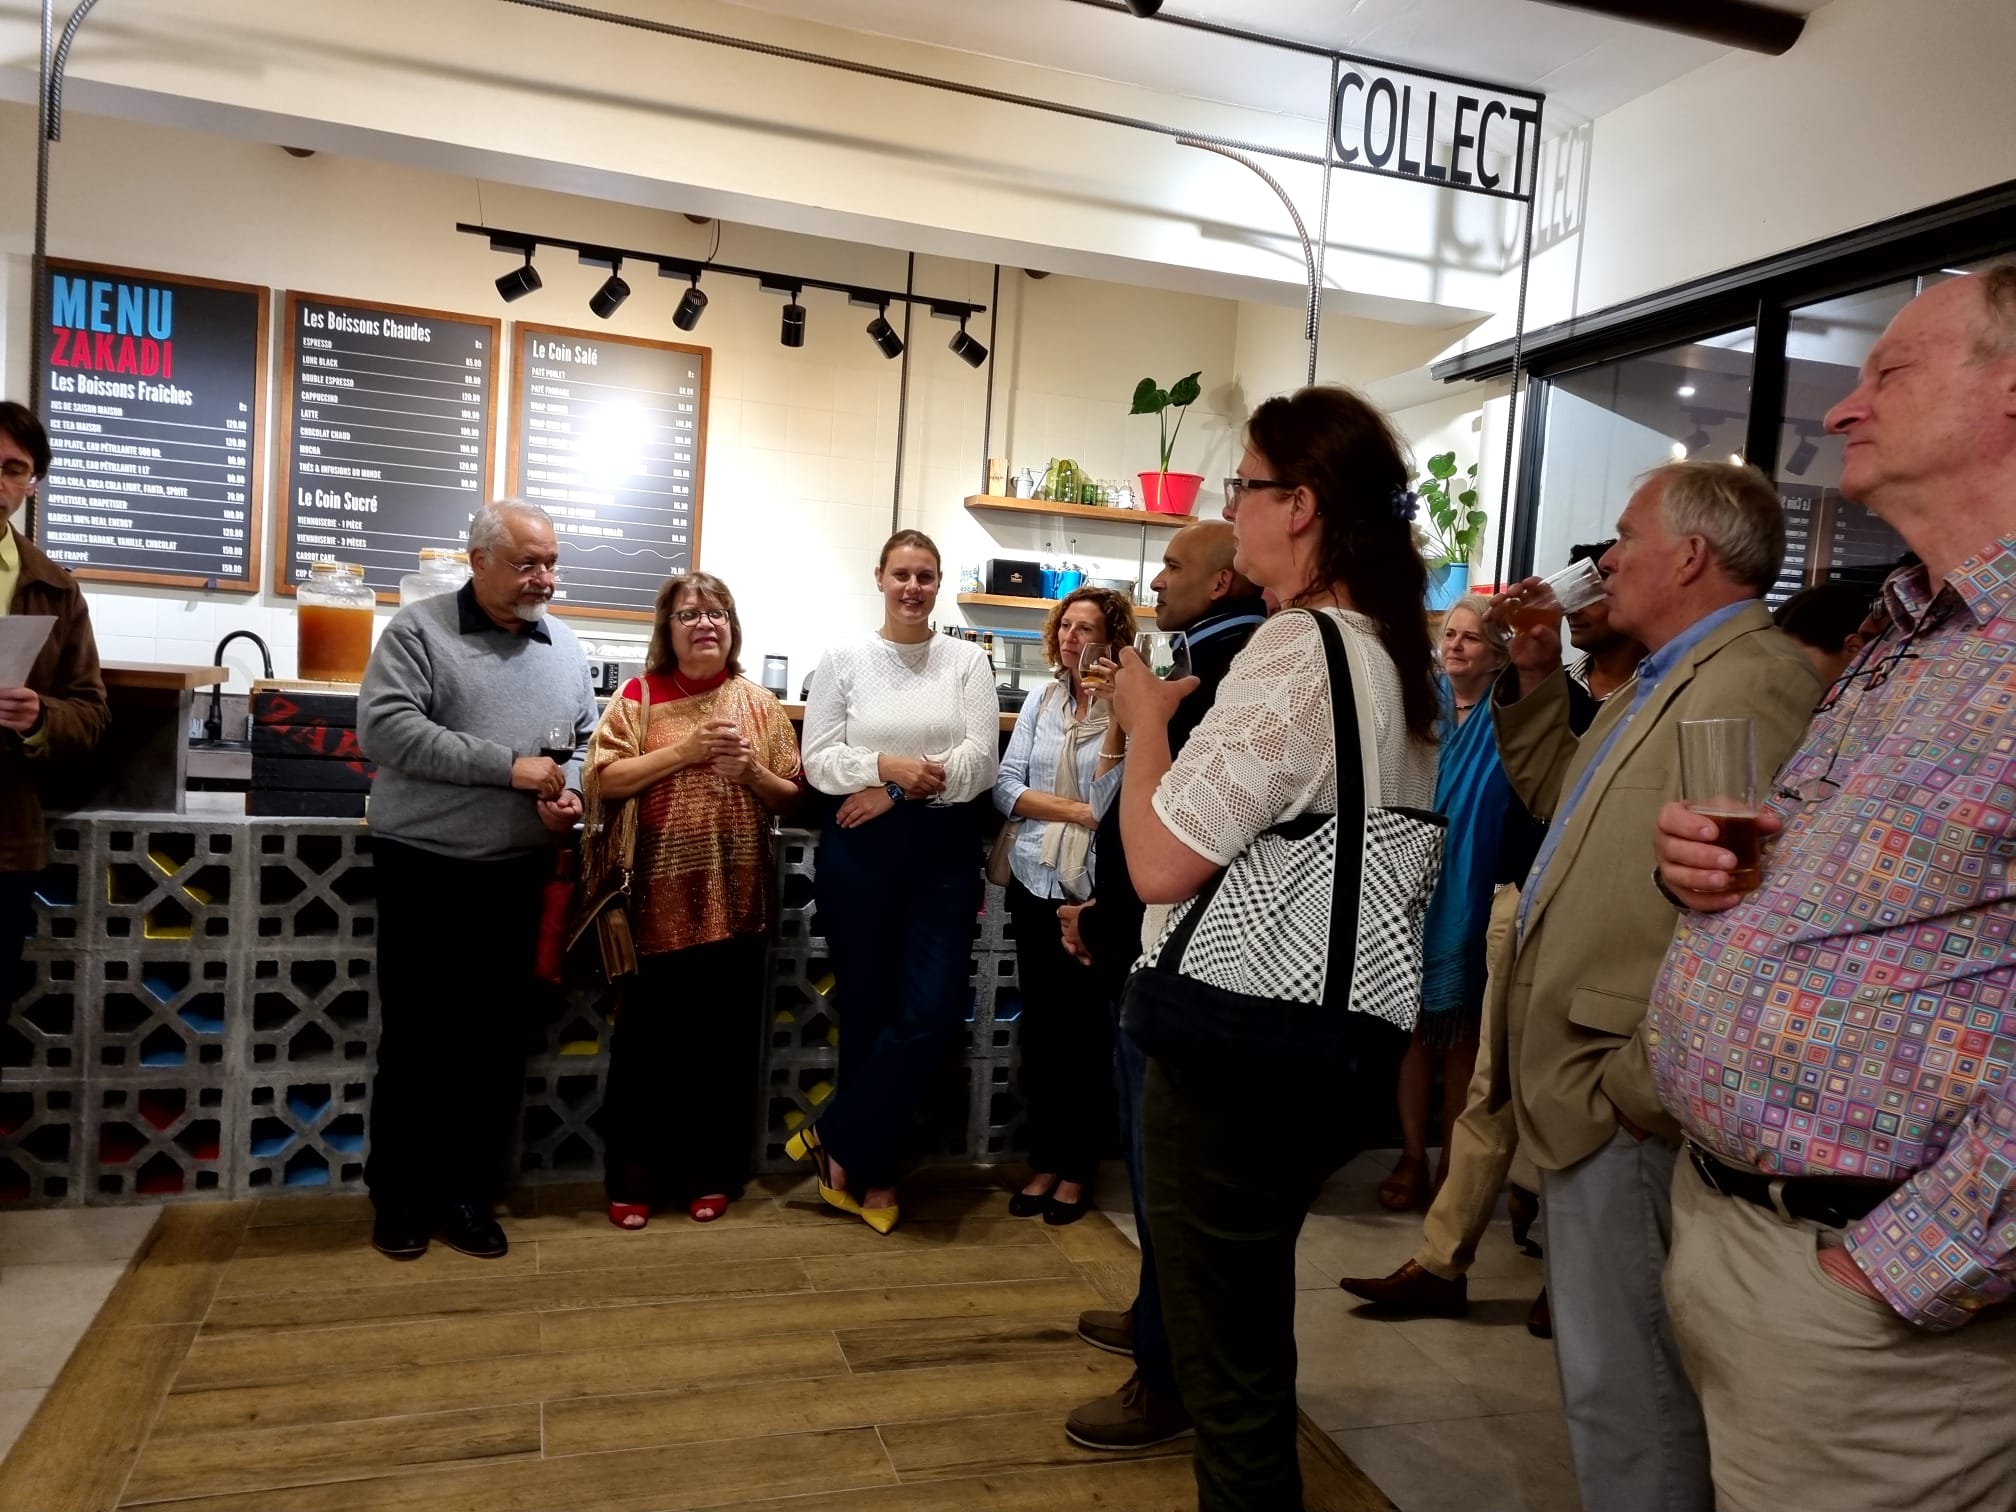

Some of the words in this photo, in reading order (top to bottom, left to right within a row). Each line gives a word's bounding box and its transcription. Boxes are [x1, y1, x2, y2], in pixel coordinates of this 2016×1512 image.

[1334, 72, 1538, 194] COLLECT
[53, 275, 173, 340] MENU
[303, 307, 325, 329] Les
[327, 310, 380, 336] Boissons
[382, 318, 431, 343] Chaudes
[302, 337, 332, 349] ESPRESSO
[50, 327, 173, 379] ZAKADI
[533, 340, 546, 358] Le
[548, 342, 572, 362] Coin
[574, 345, 598, 366] Salé
[302, 355, 318, 366] LONG
[318, 356, 338, 368] BLACK
[301, 372, 324, 384] DOUBLE
[325, 376, 354, 388] ESPRESSO
[51, 370, 75, 393] Les
[77, 373, 136, 400] Boissons
[138, 380, 193, 406] Fraîches
[301, 390, 339, 404] CAPPUCCINO
[63, 401, 73, 411] DE
[73, 402, 97, 414] SAISON
[97, 405, 123, 416] MAISON
[300, 408, 319, 420] LATTE
[50, 419, 61, 429] ICE
[62, 420, 75, 430] TEA
[76, 422, 102, 433] MAISON
[300, 426, 330, 438] CHOCOLAT
[330, 429, 351, 441] CHAUD
[49, 438, 63, 448] EAU
[64, 439, 86, 450] PLATE,
[86, 441, 100, 451] EAU
[64, 457, 86, 469] PLATE,
[86, 460, 99, 471] EAU
[299, 461, 314, 473] THÉS
[320, 464, 352, 477] INFUSIONS
[48, 475, 67, 486] COCA
[67, 477, 87, 488] COLA,
[87, 479, 104, 489] COCA
[105, 480, 122, 491] COLA
[143, 484, 165, 496] FANTA,
[166, 486, 188, 497] SPRITE
[89, 498, 128, 510] GRAPETISER
[298, 487, 312, 507] Le
[315, 489, 341, 509] Coin
[344, 491, 378, 513] Sucré
[91, 516, 108, 526] REAL
[108, 517, 133, 528] ENERGY
[297, 515, 337, 528] VIENNOISERIE
[345, 519, 363, 530] PIÈCE
[117, 537, 145, 548] VANILLE,
[145, 539, 177, 550] CHOCOLAT
[296, 533, 337, 545] VIENNOISERIE
[346, 537, 367, 548] PIÈCES
[46, 549, 64, 560] CAFÉ
[64, 551, 89, 561] FRAPPÉ
[296, 551, 319, 561] CARROT
[295, 568, 308, 578] CUP
